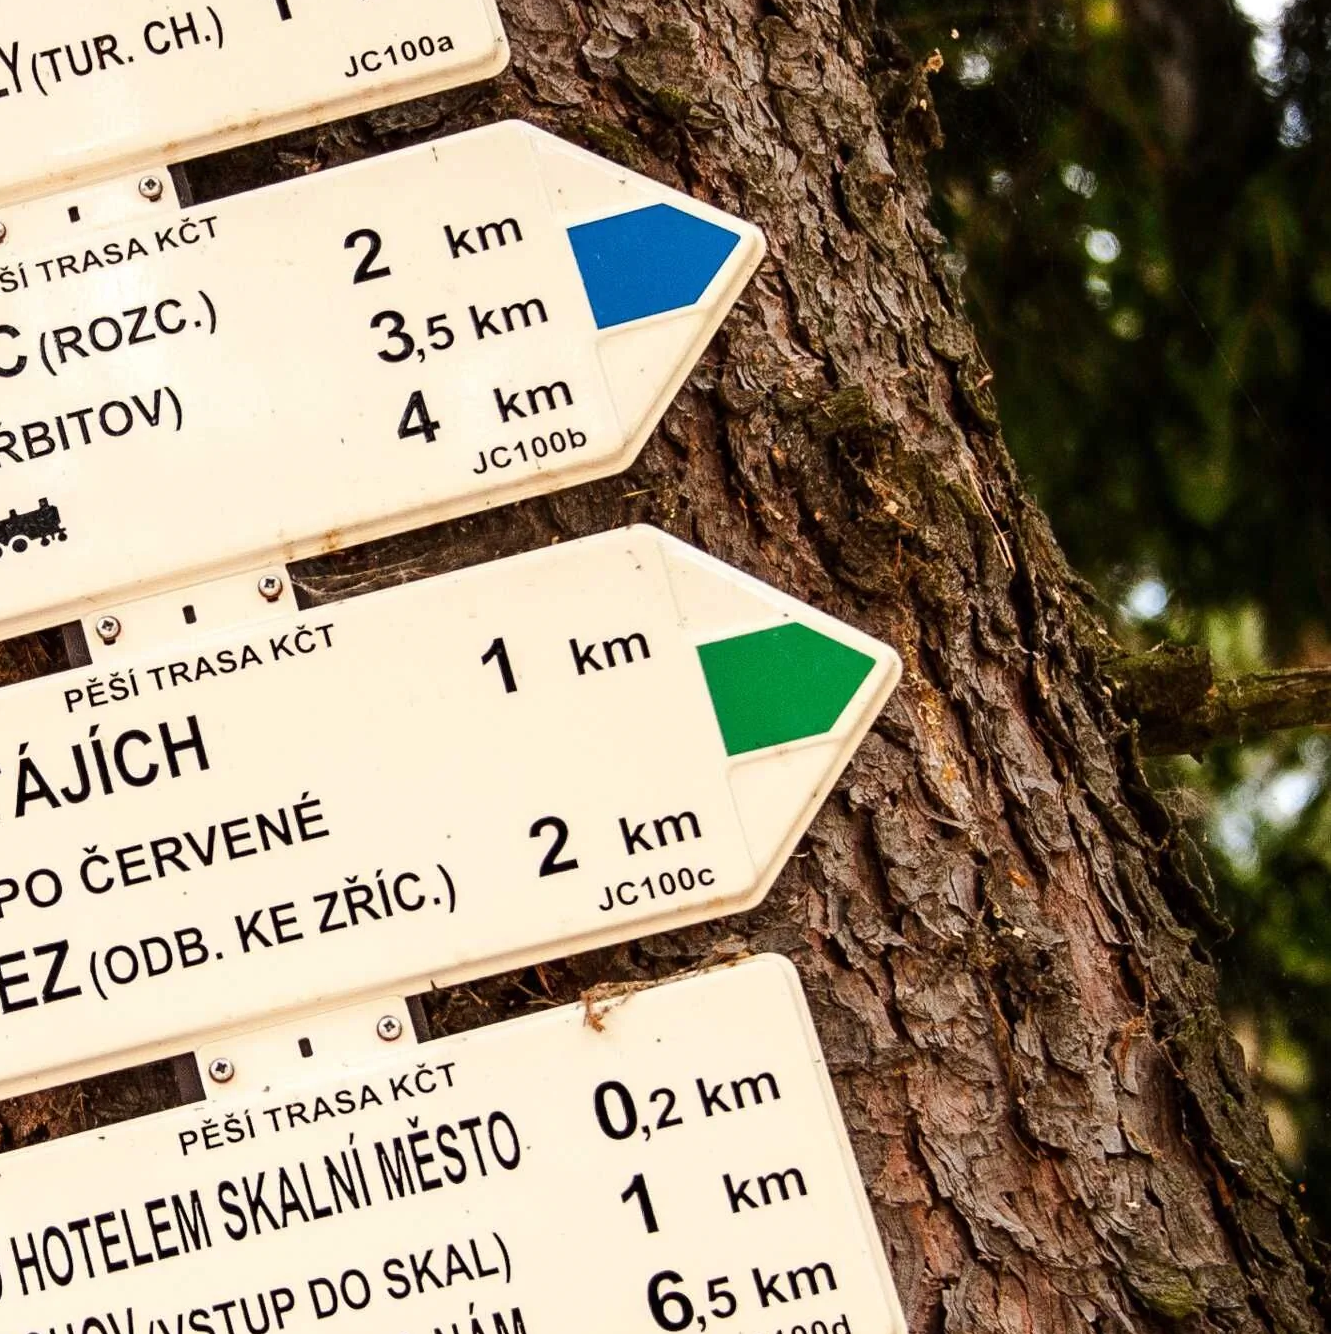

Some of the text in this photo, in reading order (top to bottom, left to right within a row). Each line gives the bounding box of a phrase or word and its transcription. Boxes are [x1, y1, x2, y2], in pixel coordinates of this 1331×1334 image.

[30, 33, 135, 97] (TUR.
[142, 4, 225, 56] CH.)
[343, 34, 455, 79] JC100a
[34, 236, 150, 283] TRASA
[153, 214, 219, 253] KČT
[38, 289, 218, 378] (ROZC.)
[342, 227, 393, 286] 2
[442, 216, 524, 260] km
[369, 309, 456, 364] 3,5
[467, 297, 550, 341] km
[396, 388, 442, 445] 4
[491, 379, 575, 424] km
[472, 427, 588, 476] JC100b
[62, 622, 335, 714] PĚŠÍ TRASA KČT
[479, 636, 519, 695] 1
[567, 631, 652, 677] km
[78, 790, 331, 896] ČERVENÉ
[88, 926, 225, 1002] (ODB.
[233, 900, 305, 955] KE
[311, 863, 457, 935] ZŘÍC.)
[528, 814, 580, 879] 2
[617, 810, 703, 857] km
[597, 866, 716, 913] JC100c
[177, 1061, 457, 1157] PĚŠÍ TRASA KČT
[9, 1188, 213, 1297] HOTELEM
[216, 1131, 373, 1242] SKALNÍ
[372, 1109, 522, 1202] MĚSTO
[593, 1079, 685, 1143] 0,2
[694, 1071, 782, 1118] km
[306, 1267, 372, 1321] DO
[381, 1231, 512, 1301] SKAL)
[619, 1172, 661, 1235] 1
[721, 1166, 809, 1215] km
[646, 1268, 738, 1334] 6,5
[750, 1261, 839, 1309] km
